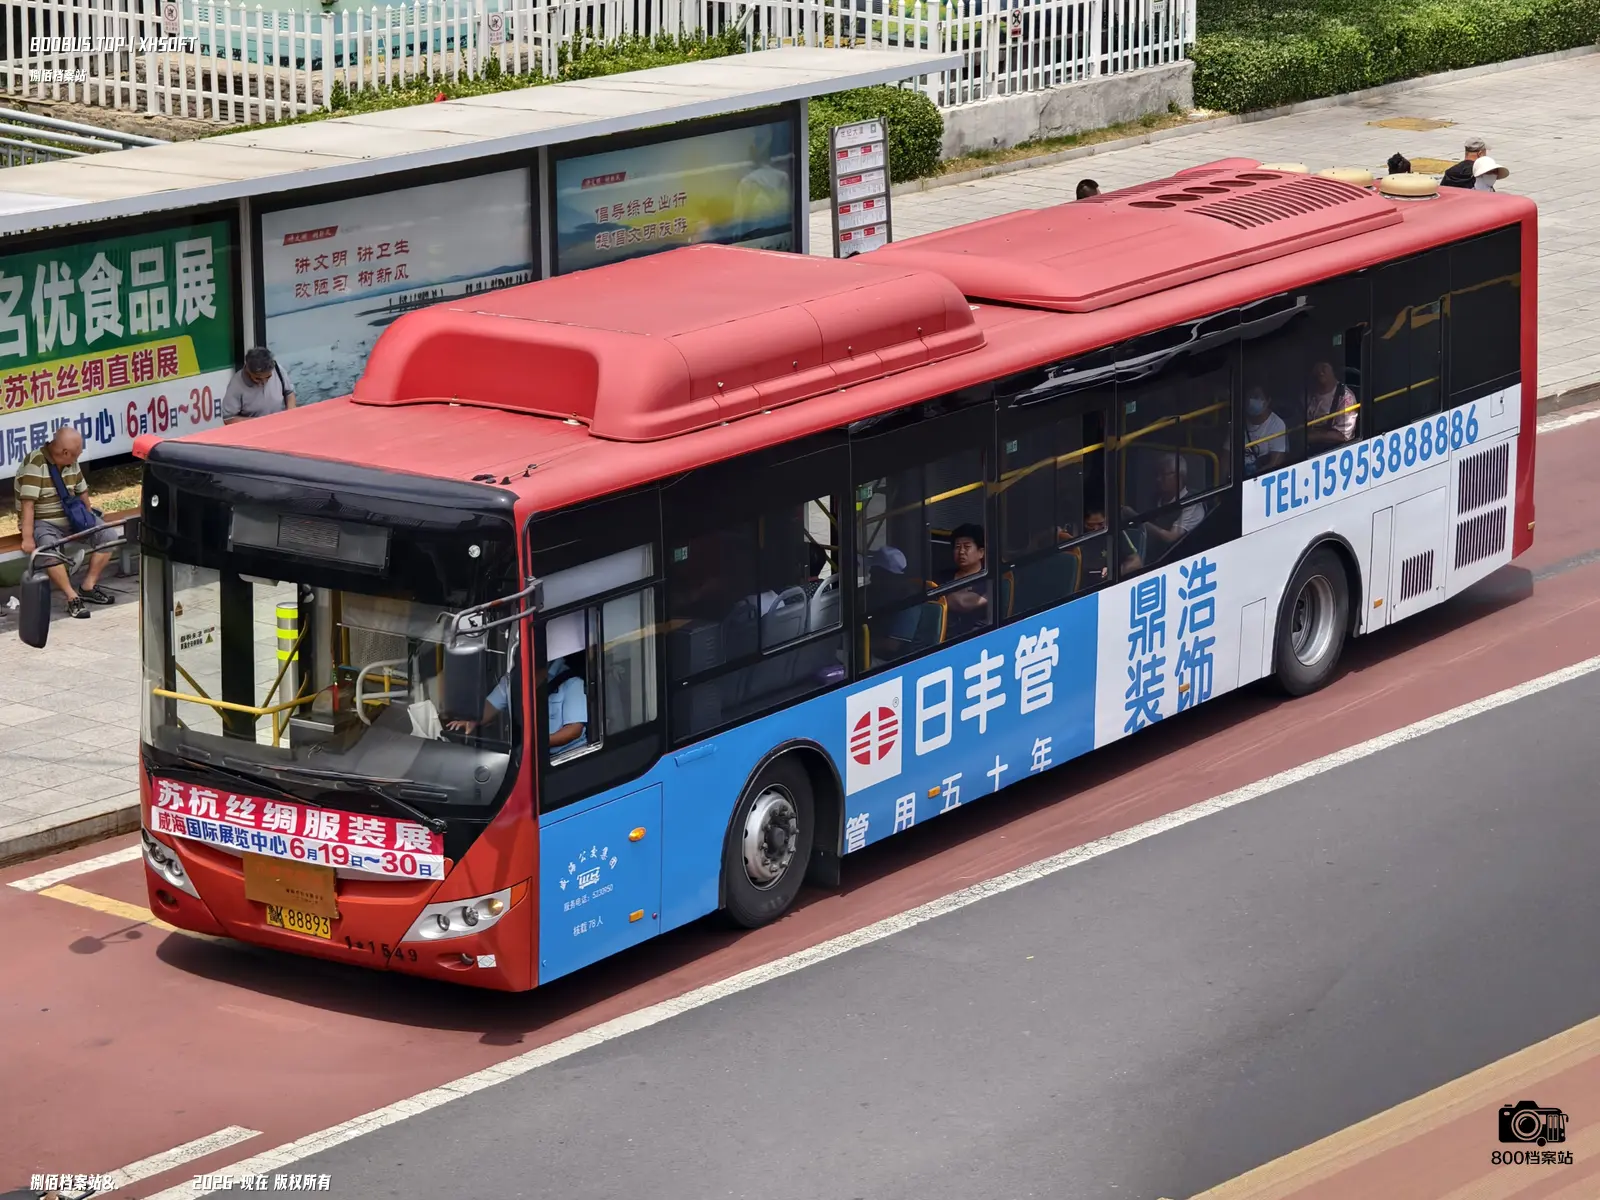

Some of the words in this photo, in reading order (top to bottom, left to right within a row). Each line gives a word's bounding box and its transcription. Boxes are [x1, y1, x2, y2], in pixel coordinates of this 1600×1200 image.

[595, 191, 687, 223] 倡导绿色出行
[595, 217, 688, 249] 提倡文明旅游
[295, 250, 348, 274] 讲文明
[357, 239, 410, 262] 讲卫生
[295, 275, 349, 298] 改陋习
[357, 263, 409, 287] 树新风
[0, 236, 217, 357] 名优食品展
[0, 345, 179, 411] 苏杭丝绸直销展
[1261, 403, 1479, 518] TEL:15953888886
[915, 626, 1060, 756] 日丰管
[157, 779, 433, 854] 苏杭丝绸服装展
